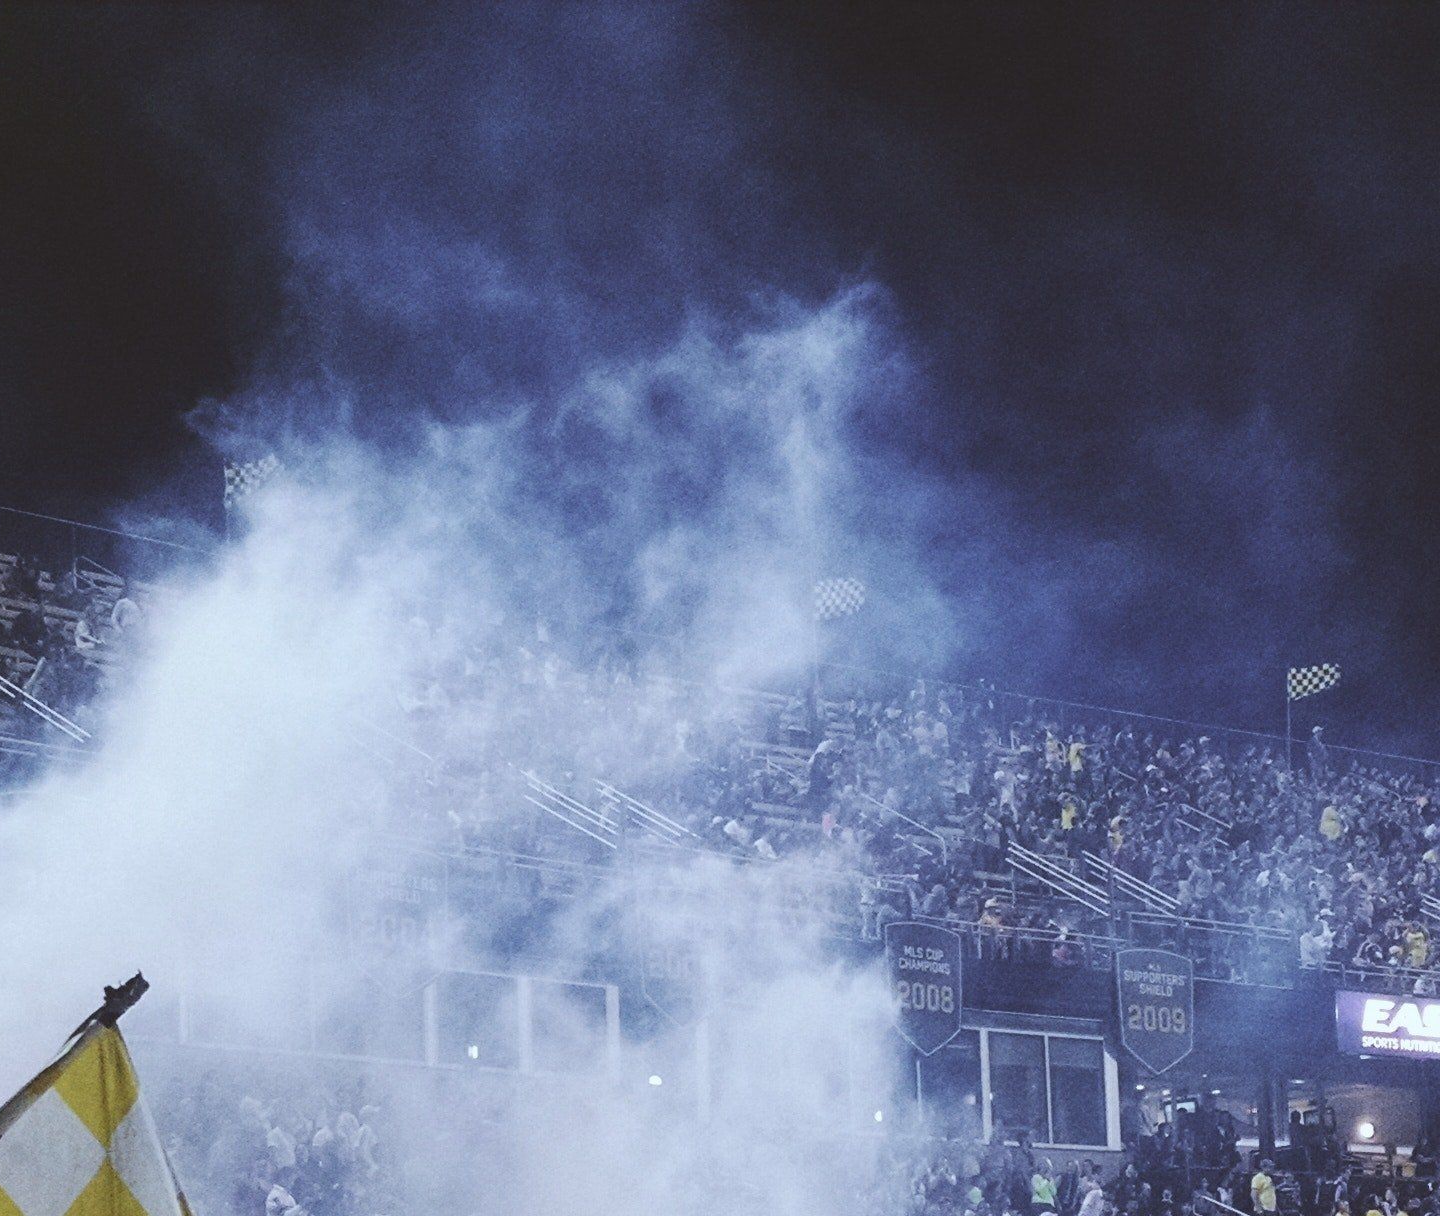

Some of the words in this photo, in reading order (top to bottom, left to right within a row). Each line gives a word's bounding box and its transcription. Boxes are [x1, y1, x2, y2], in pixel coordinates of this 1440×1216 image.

[903, 945, 924, 959] MLS
[926, 948, 945, 961] CUP
[898, 957, 951, 975] CHAMPIONS
[896, 979, 955, 1014] 2008
[1140, 983, 1173, 997] SHIELD
[1127, 1004, 1186, 1033] 2009
[1361, 1035, 1399, 1050] SPORTS
